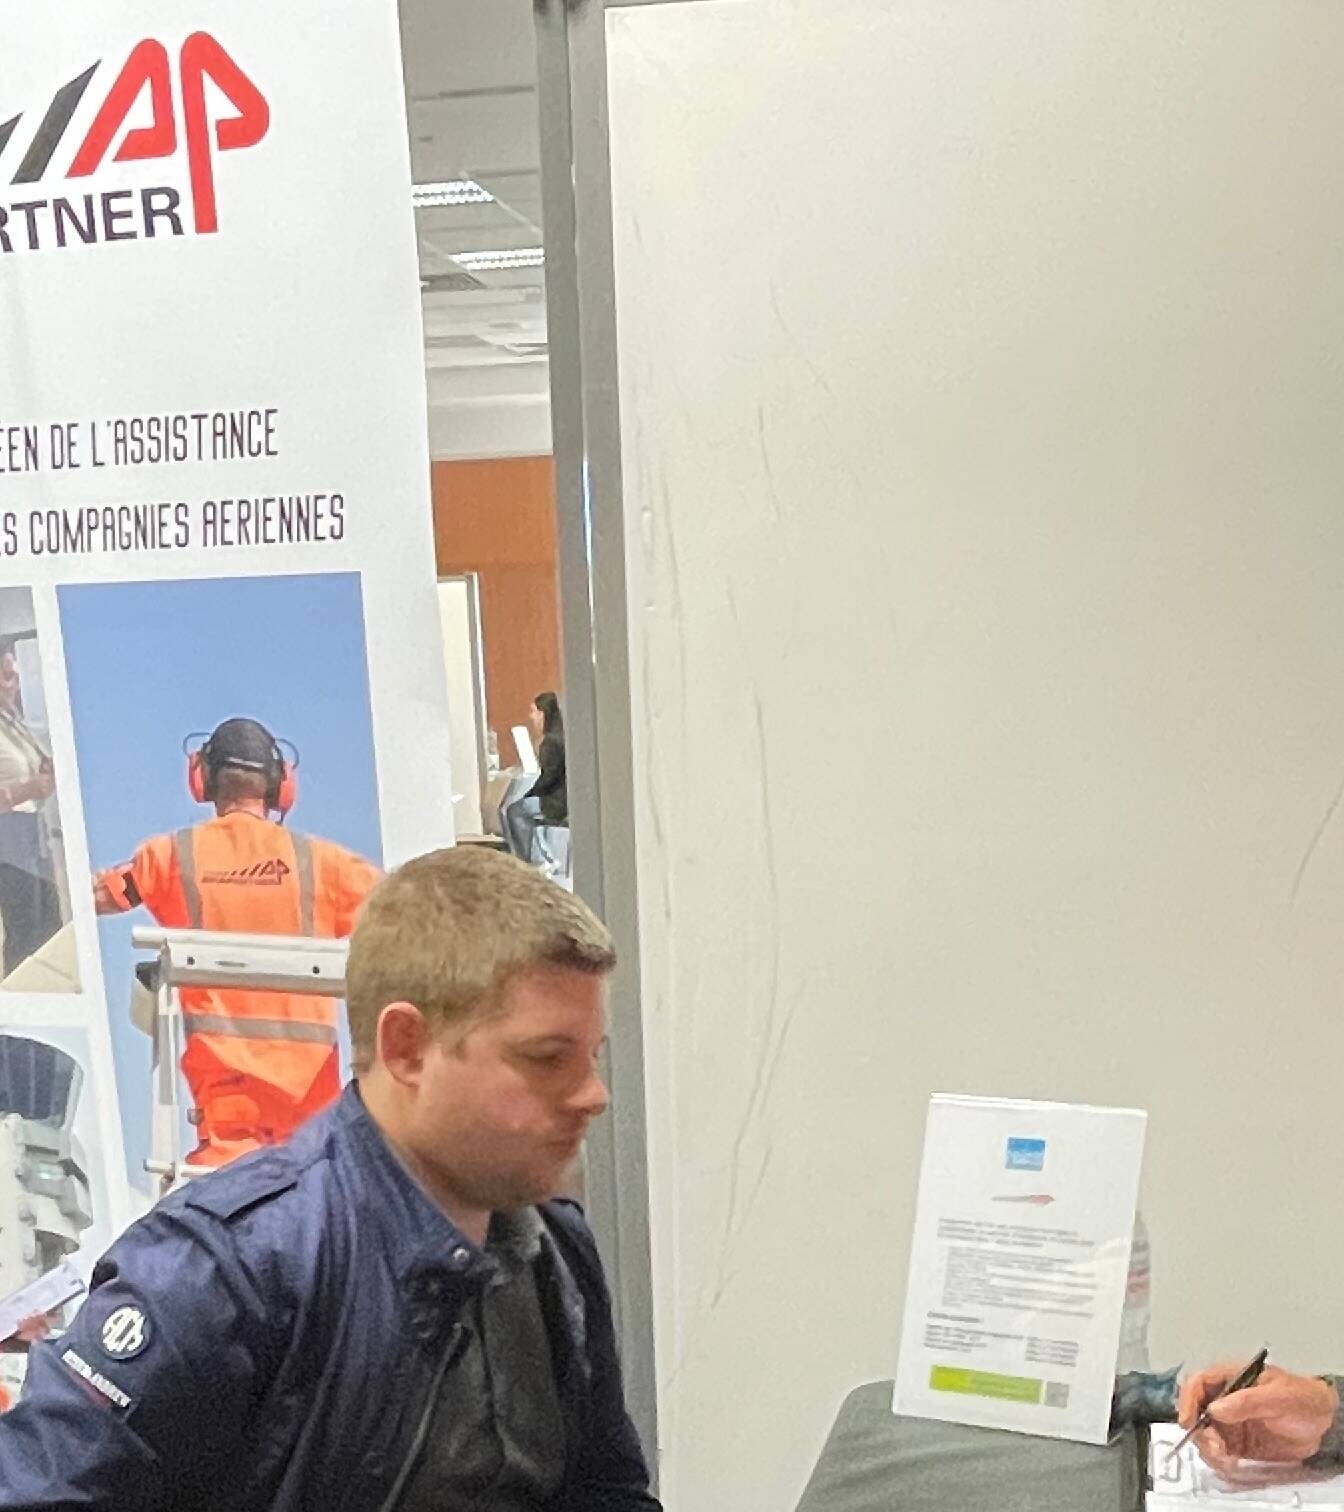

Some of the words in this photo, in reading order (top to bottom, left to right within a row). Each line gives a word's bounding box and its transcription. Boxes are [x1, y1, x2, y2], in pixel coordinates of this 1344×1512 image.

[64, 30, 270, 234] AP
[50, 422, 80, 470] DE
[91, 408, 279, 468] L'ASSISTANCE
[29, 502, 190, 555] COMPAGNIES
[202, 493, 345, 548] AERIENNES
